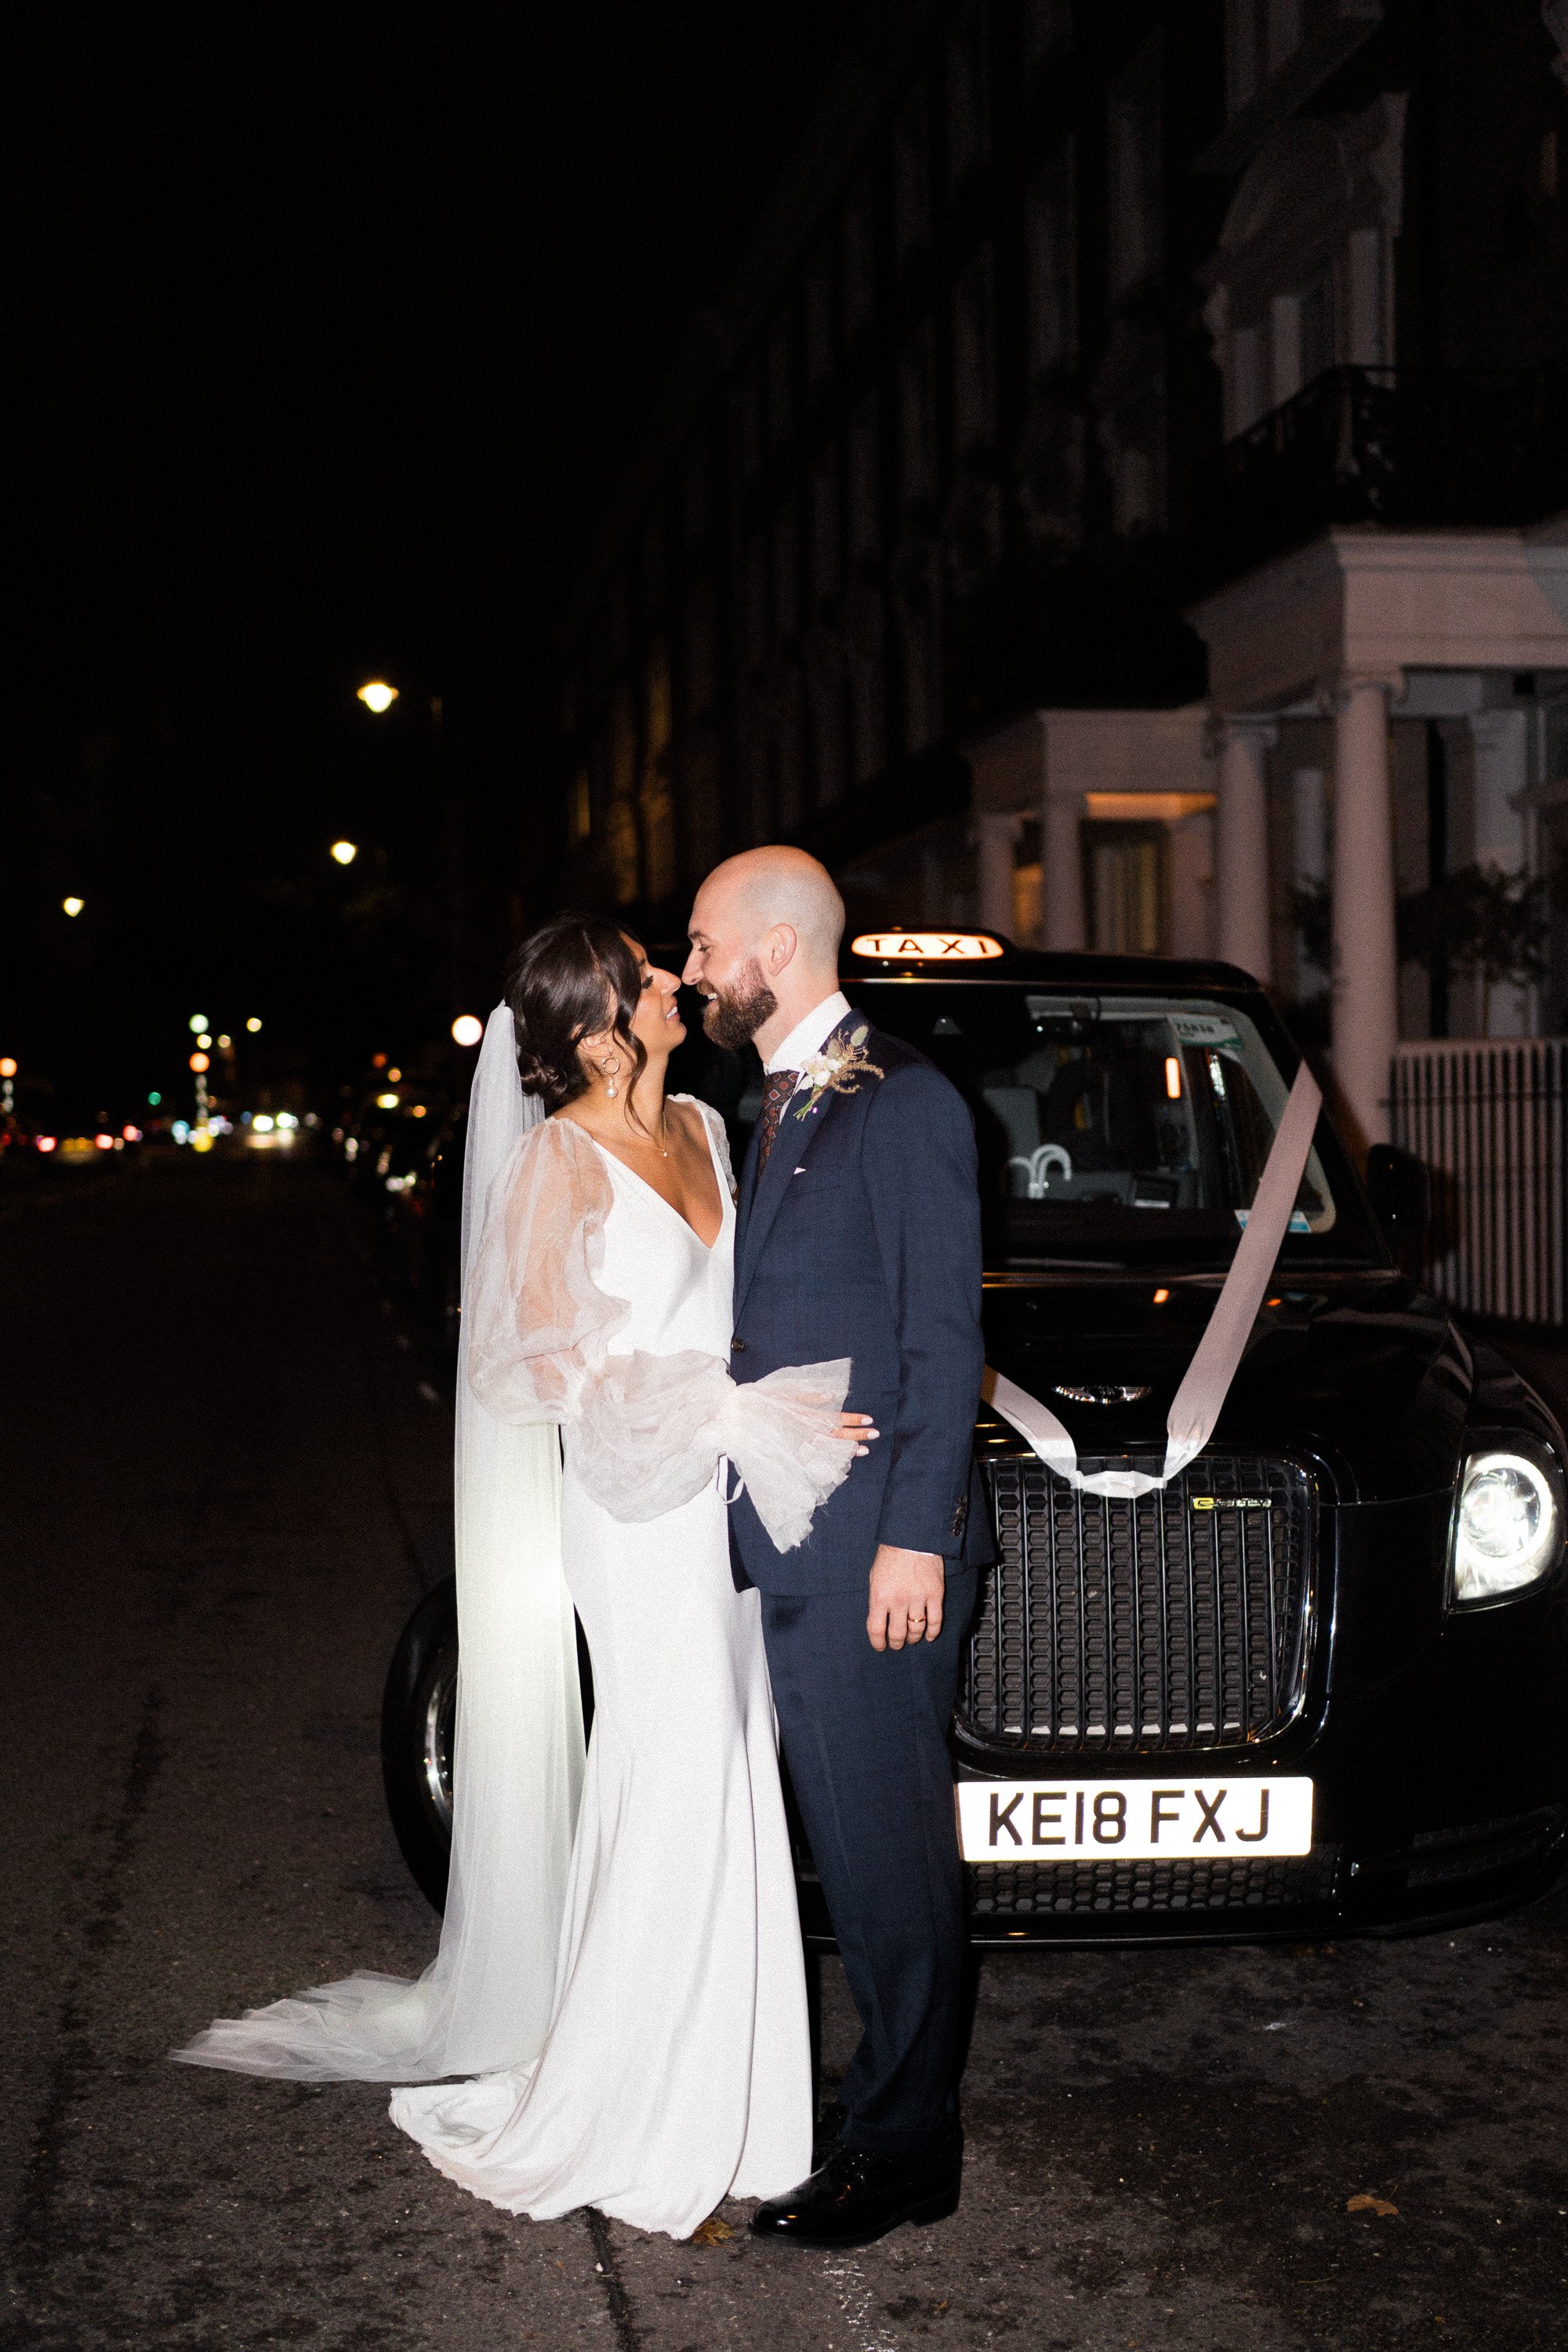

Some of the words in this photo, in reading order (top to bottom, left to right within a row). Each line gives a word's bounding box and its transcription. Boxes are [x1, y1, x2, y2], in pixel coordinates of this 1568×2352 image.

[866, 938, 988, 954] TAXI
[989, 1791, 1127, 1846] KE18
[1150, 1788, 1270, 1844] FXJ
